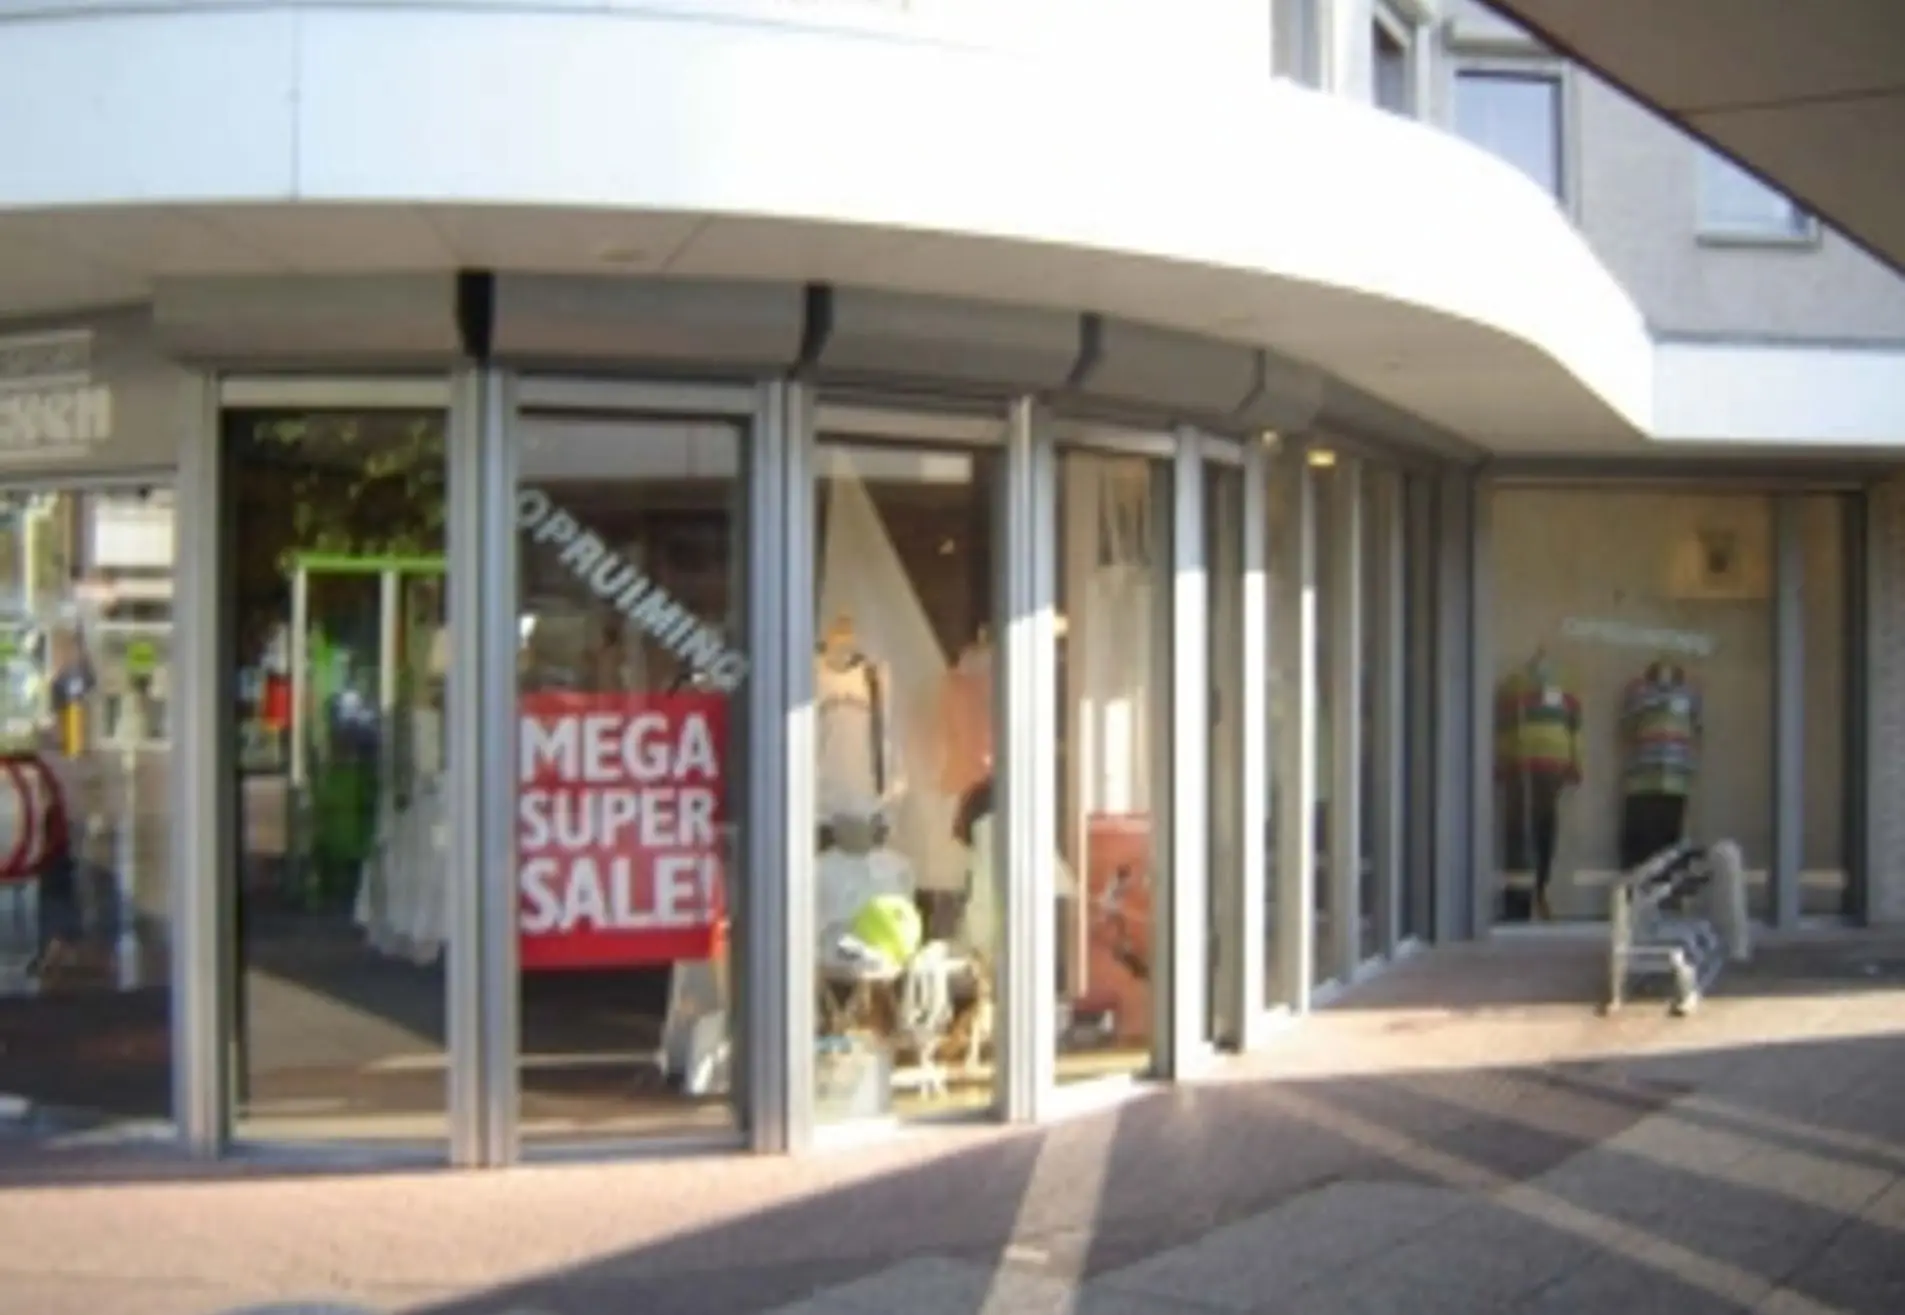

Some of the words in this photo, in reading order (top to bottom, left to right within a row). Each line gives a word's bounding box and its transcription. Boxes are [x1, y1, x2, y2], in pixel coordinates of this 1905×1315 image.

[519, 713, 719, 781] MEGA
[519, 787, 719, 849] SUPER
[519, 856, 721, 932] SALE!
